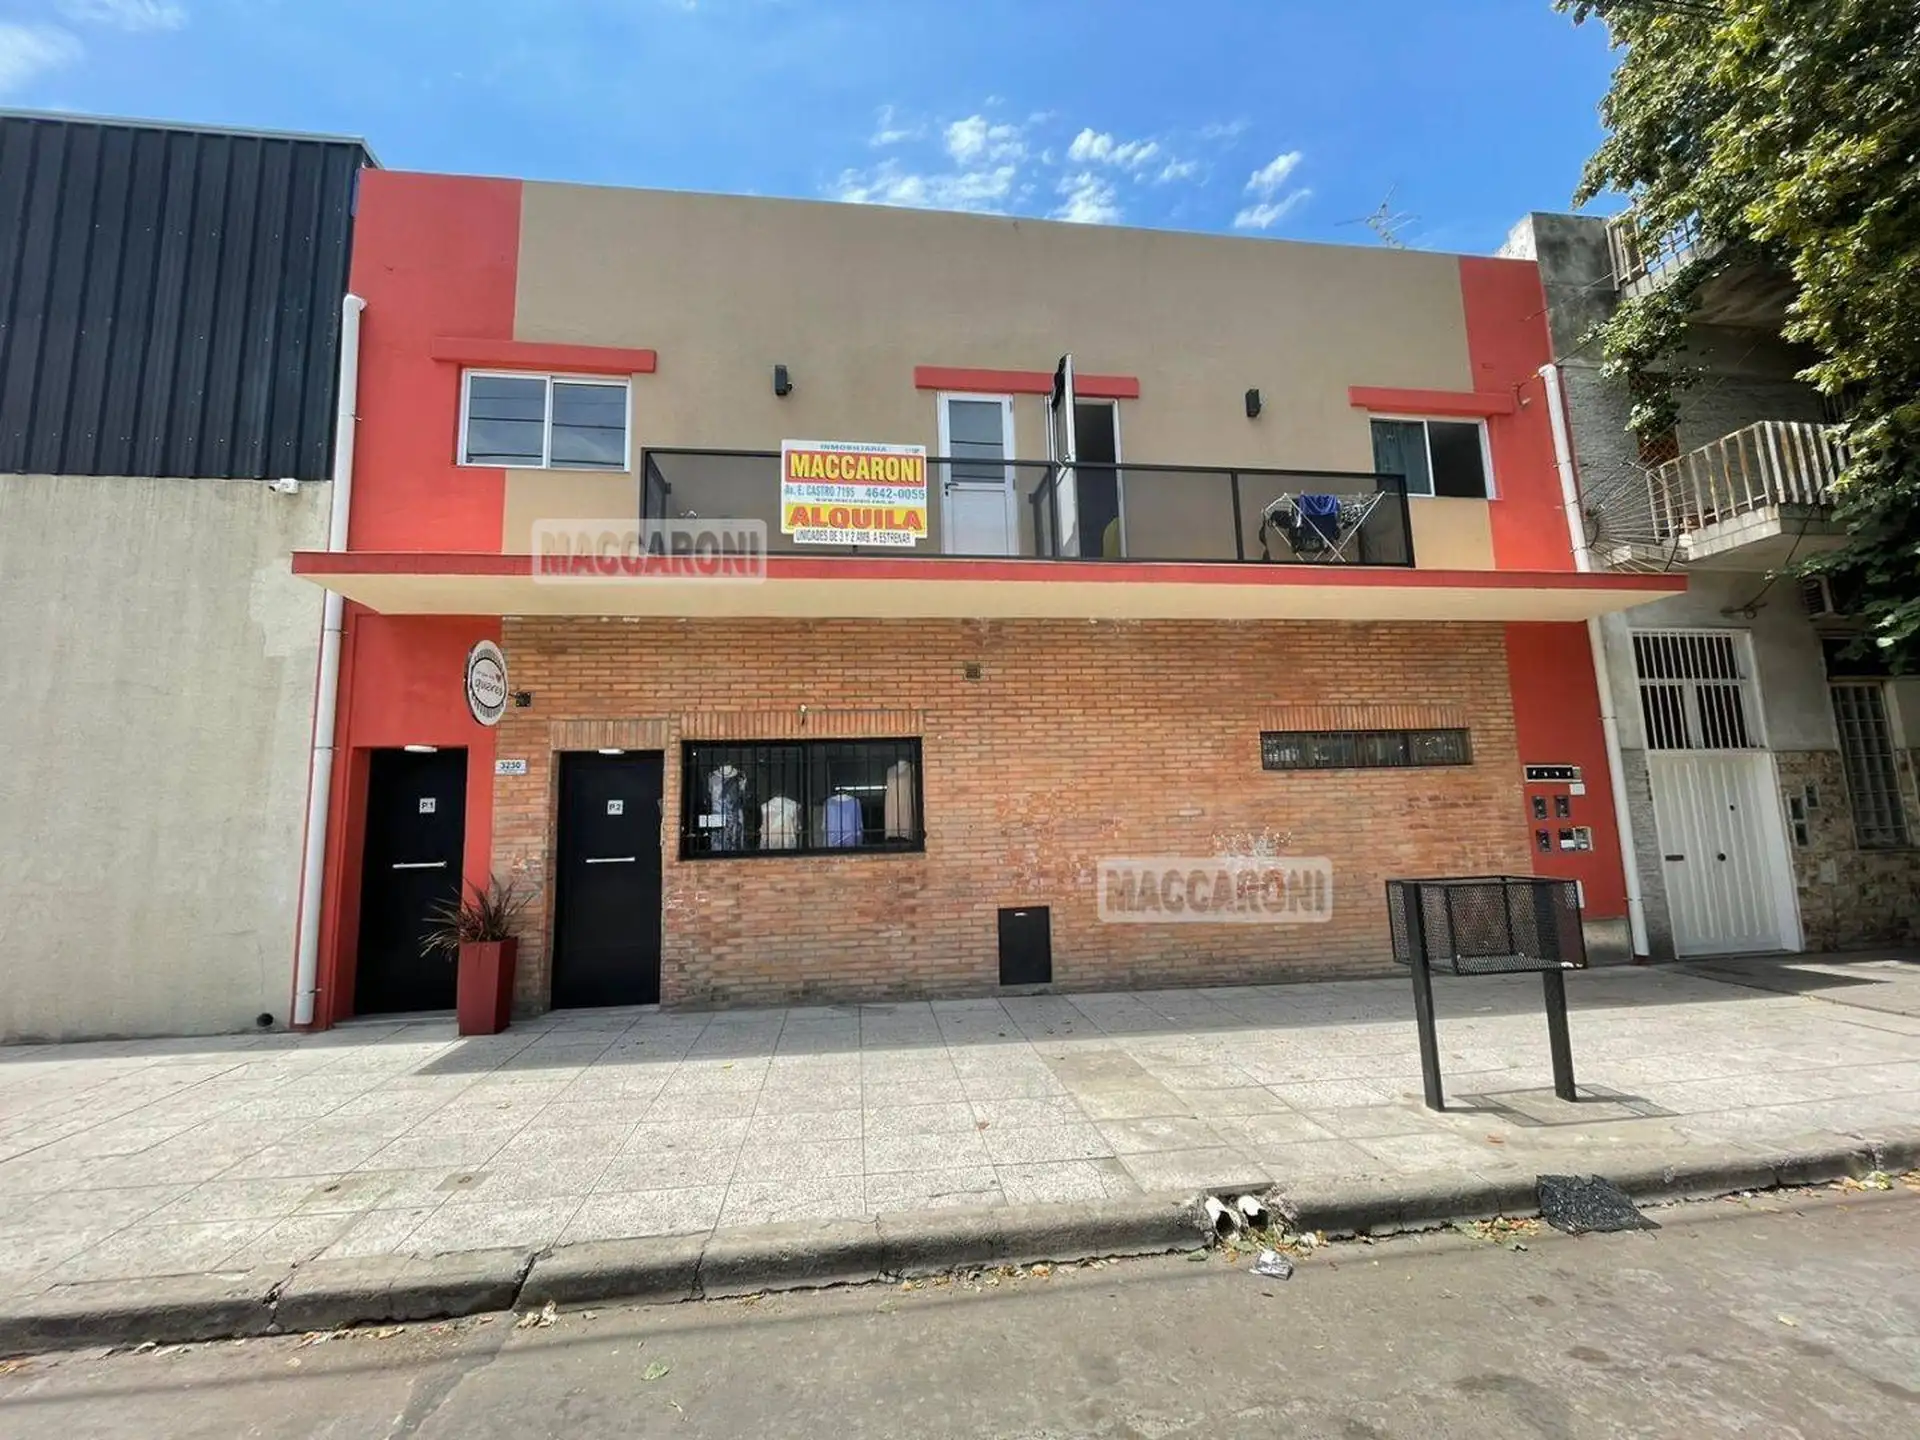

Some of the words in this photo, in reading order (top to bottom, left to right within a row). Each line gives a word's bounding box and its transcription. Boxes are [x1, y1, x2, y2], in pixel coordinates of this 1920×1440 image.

[790, 453, 922, 482] MACCARONI
[806, 486, 836, 497] CASTRO
[865, 488, 925, 500] 4642-0055
[788, 506, 922, 530] ALQUILA
[796, 529, 828, 541] UNIDADES
[829, 530, 838, 542] DE
[879, 532, 912, 544] ESTRENAR
